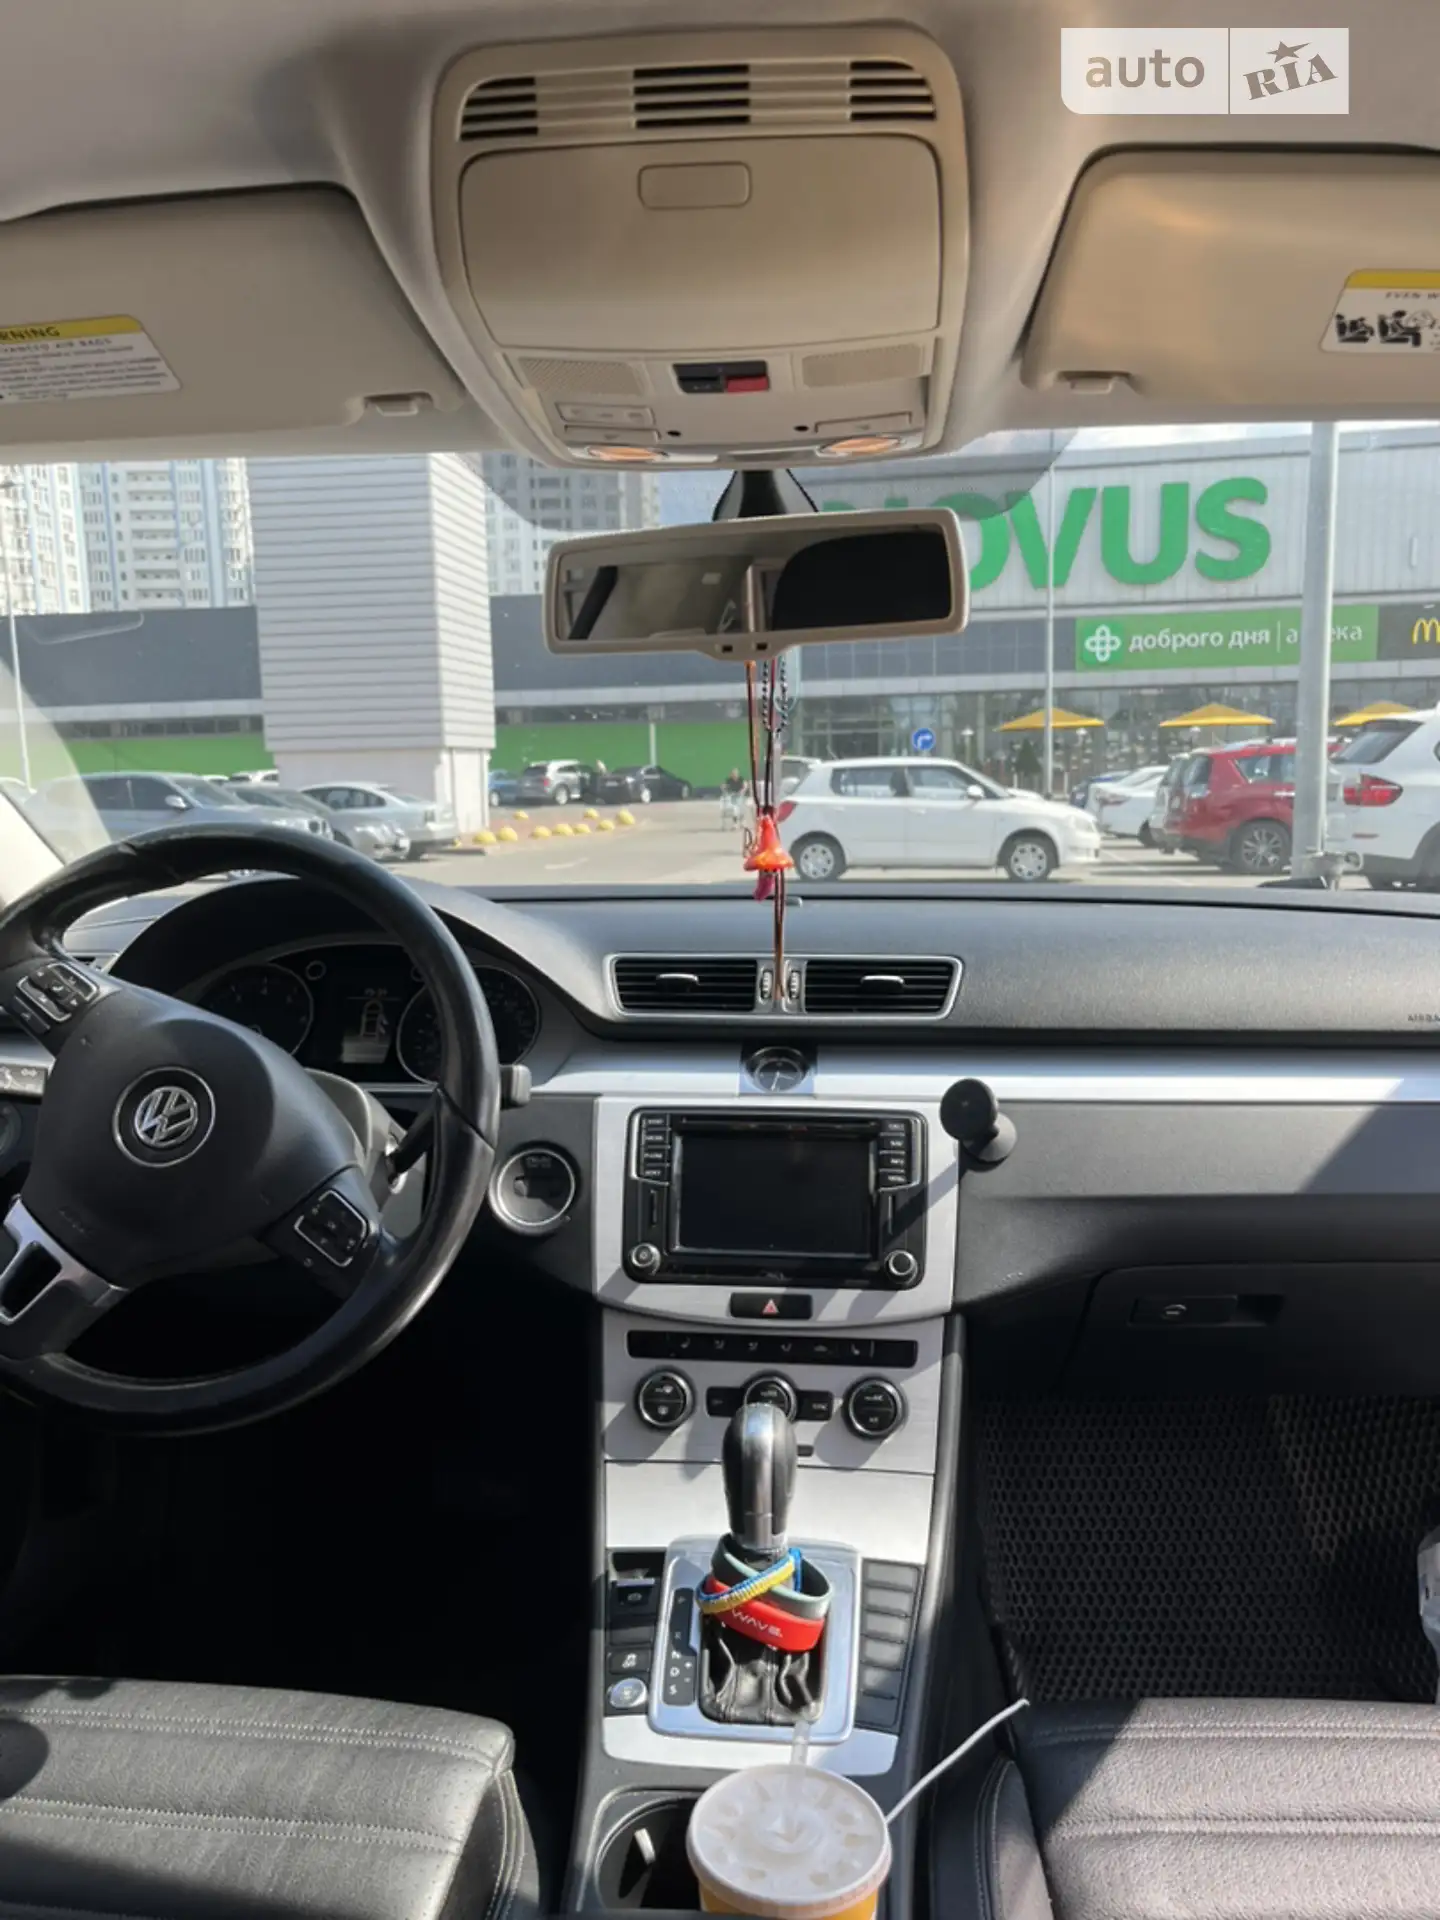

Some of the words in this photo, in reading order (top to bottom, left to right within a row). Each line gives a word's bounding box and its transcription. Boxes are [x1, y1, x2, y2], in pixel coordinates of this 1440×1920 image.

[1128, 627, 1224, 654] доброго
[1228, 628, 1271, 650] дня
[1286, 625, 1363, 645] аека
